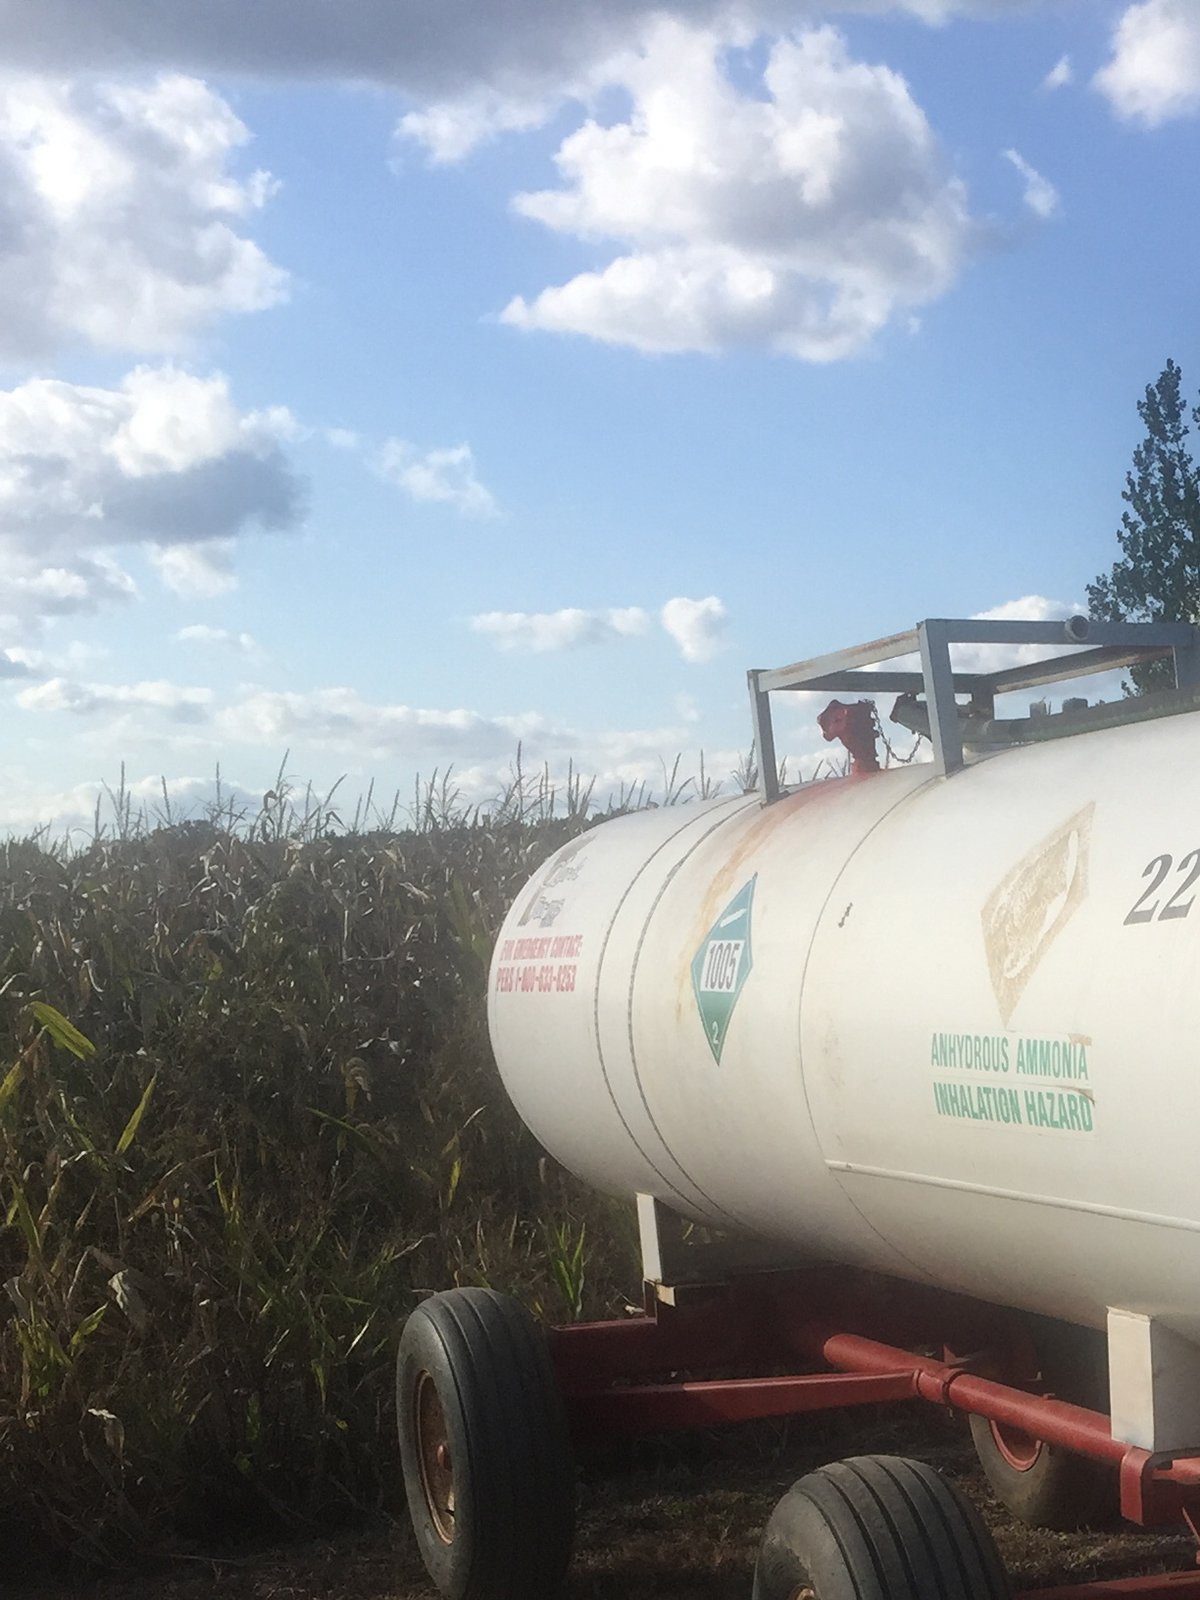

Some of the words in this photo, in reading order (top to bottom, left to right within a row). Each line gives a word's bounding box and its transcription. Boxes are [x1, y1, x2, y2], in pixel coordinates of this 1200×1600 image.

[705, 942, 741, 990] 1005
[712, 1020, 719, 1044] 2
[931, 1032, 1010, 1073] ANHYDROUS
[1016, 1038, 1089, 1081] AMMONIA
[933, 1081, 1023, 1125] INHALATION
[1023, 1090, 1094, 1132] HAZARD
